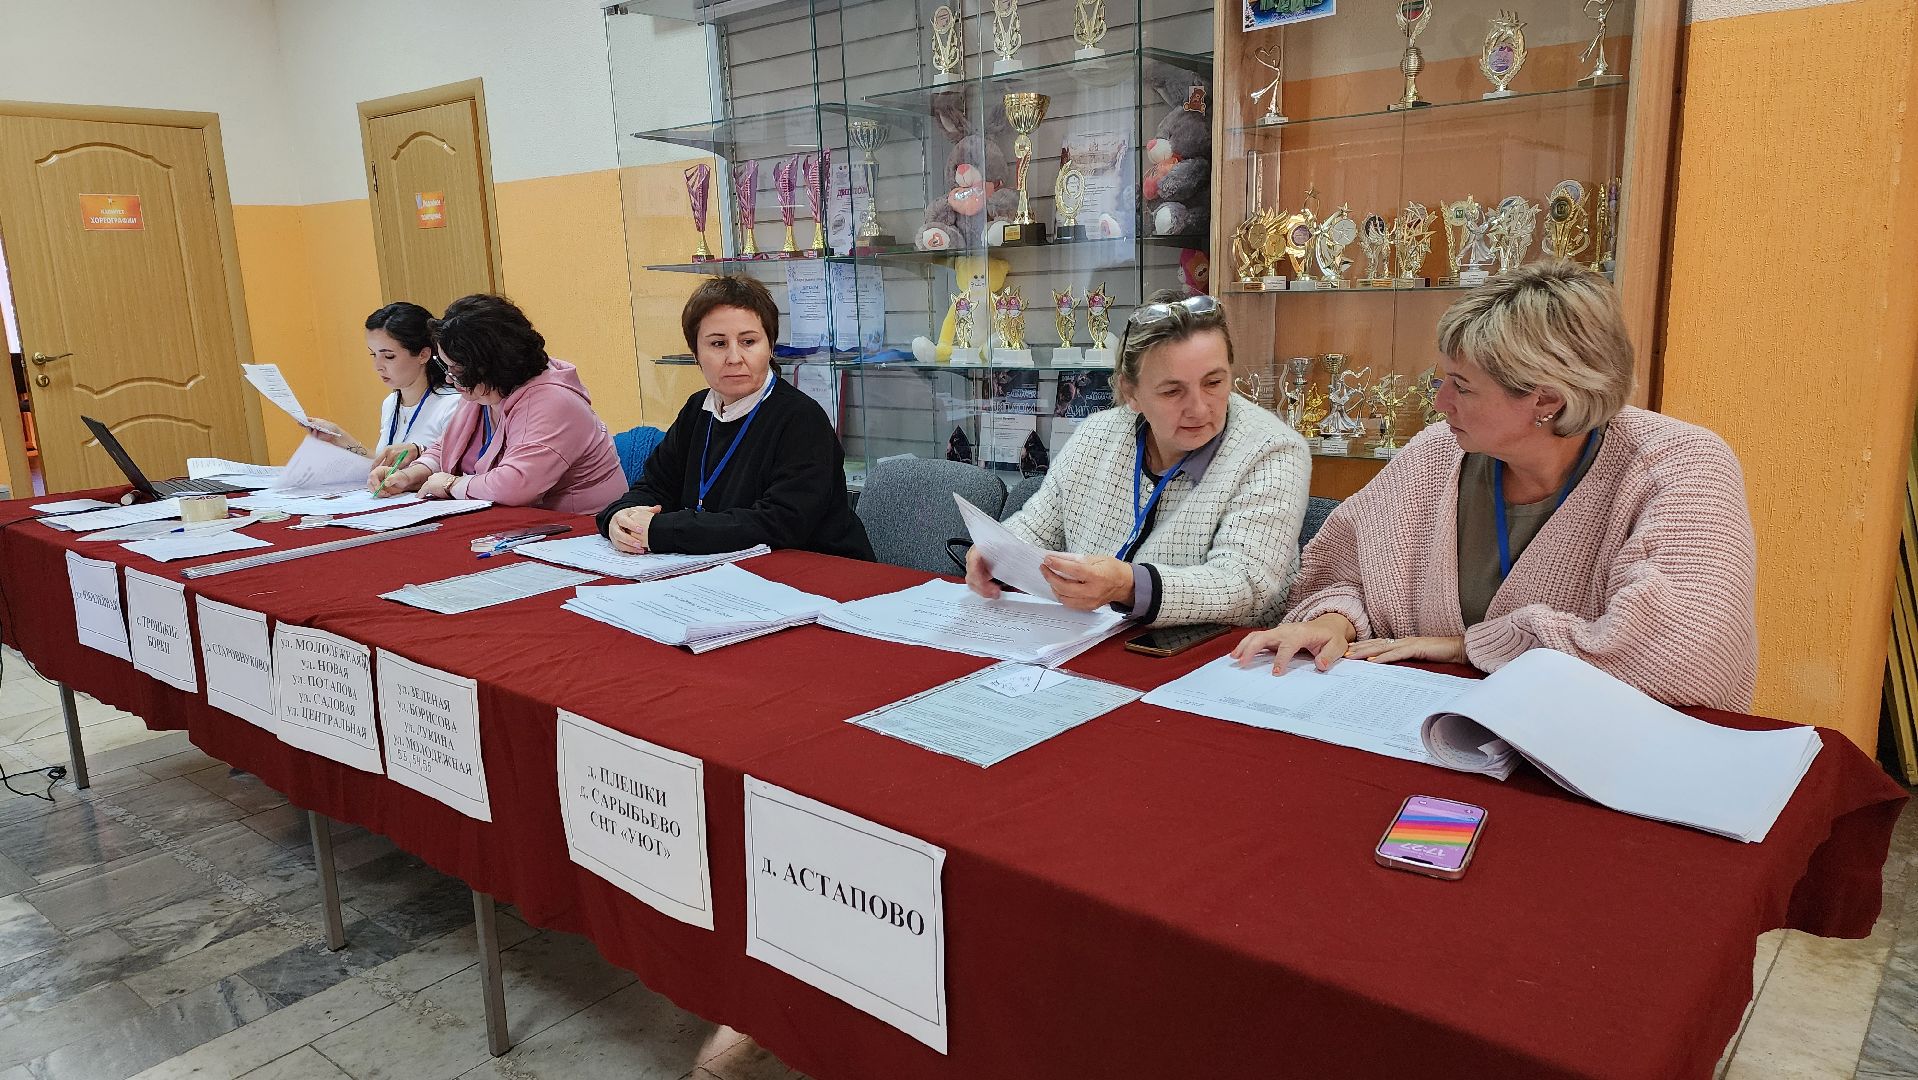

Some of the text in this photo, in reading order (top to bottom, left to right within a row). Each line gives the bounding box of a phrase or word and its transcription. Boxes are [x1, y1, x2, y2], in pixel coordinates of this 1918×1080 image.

[280, 638, 293, 650] ул.
[301, 659, 315, 671] ул.
[317, 659, 349, 680] НОВАЯ
[292, 674, 358, 701] ул. ПОТАПОВА
[299, 692, 356, 717] ул. САДОВАЯ
[397, 683, 451, 713] ул. ЗЕЛЕНАЯ
[286, 705, 367, 740] ул. ЦЕНТРАЛЬНАЯ
[397, 700, 458, 734] ул. БОРИСОВА
[404, 721, 455, 751] ул. ЛУКИНА
[393, 734, 473, 777] ул. МОЛОДЕЖНАЯ
[587, 765, 668, 808] д. ПЛЕШКИ
[579, 785, 681, 838] д. САРЫБЬЕВО
[590, 810, 671, 860] СНТ «УЮТ»
[761, 856, 925, 936] д. АСТАПОВО
